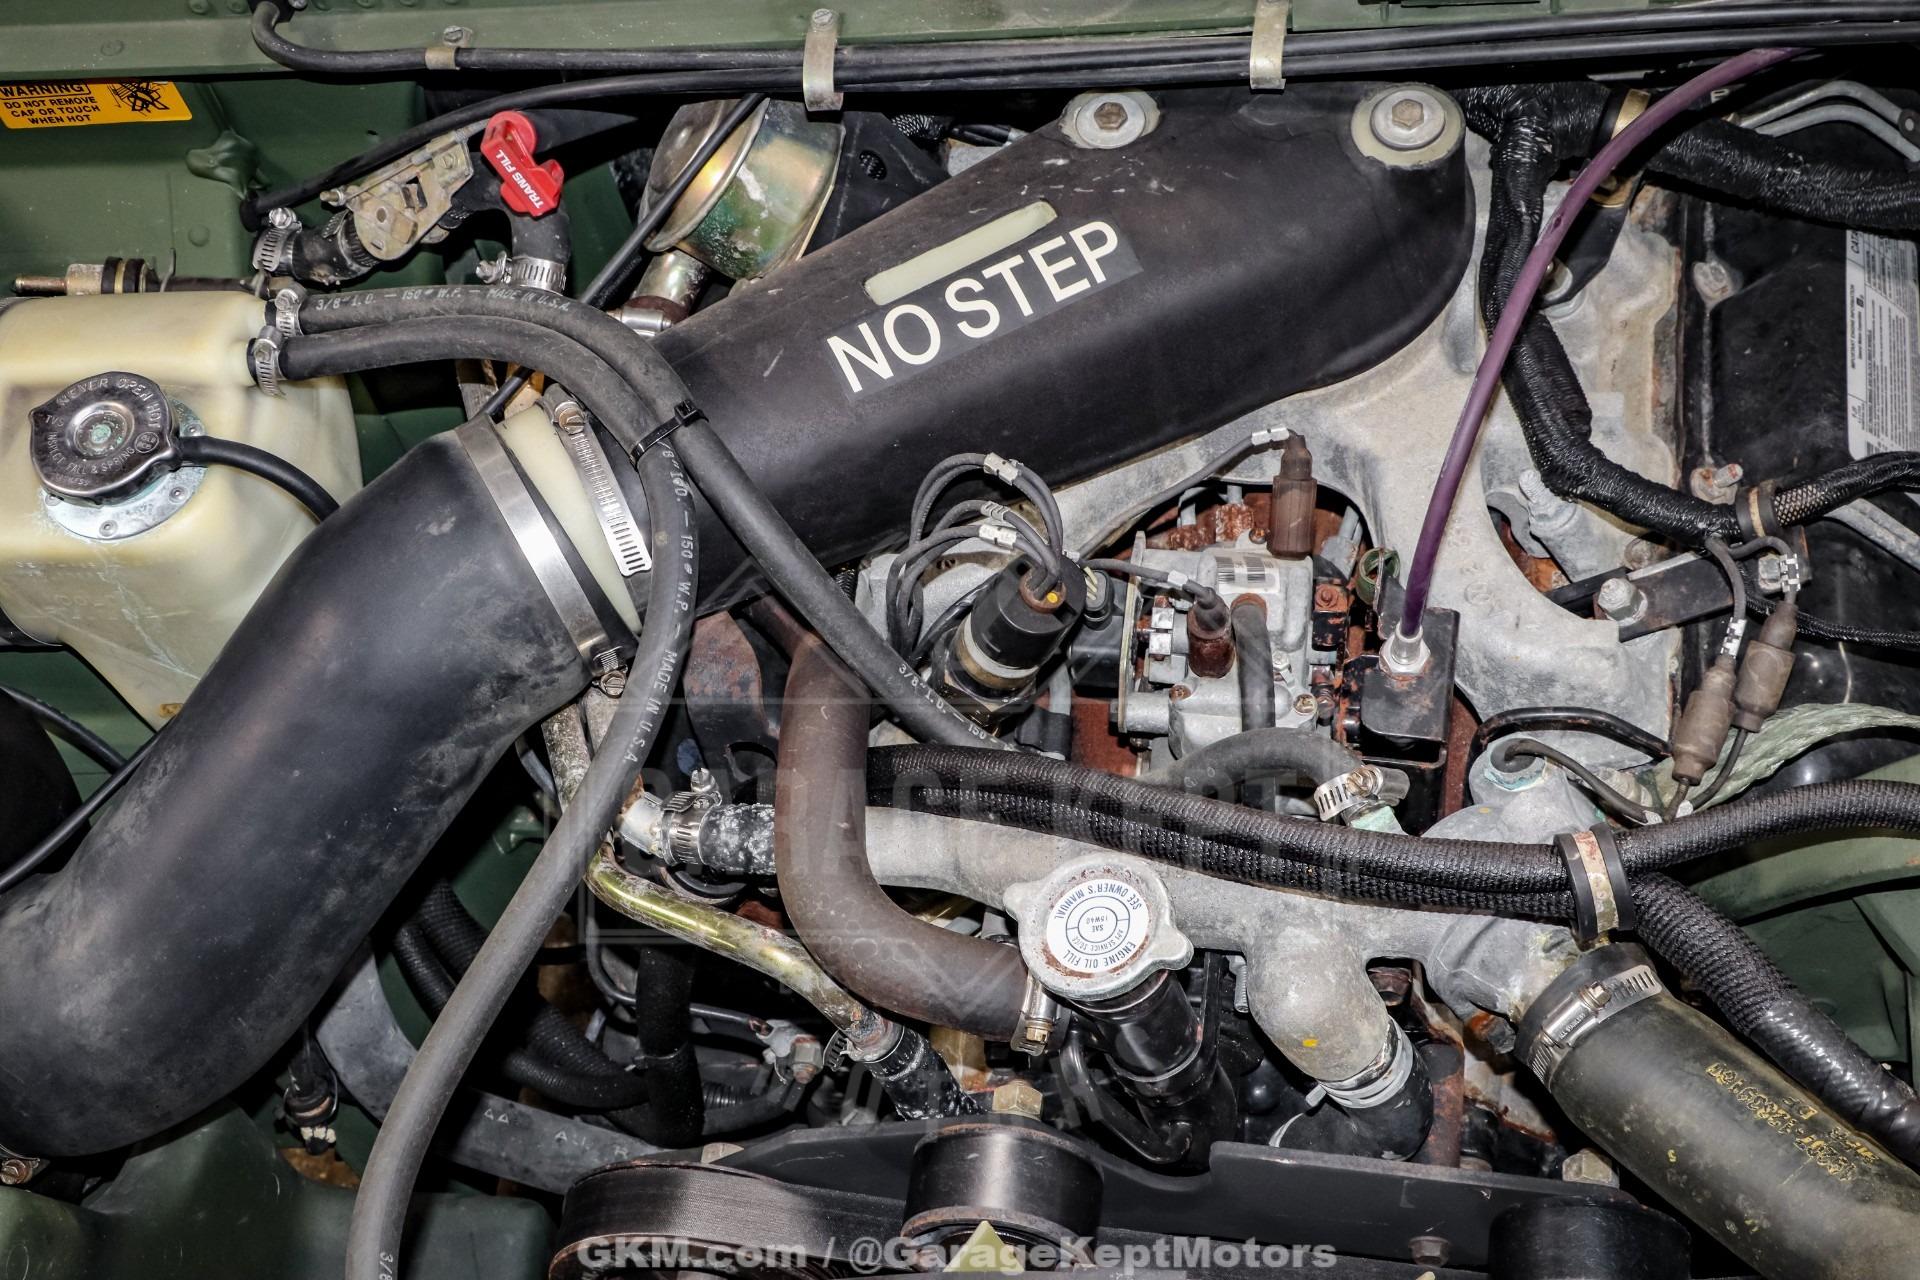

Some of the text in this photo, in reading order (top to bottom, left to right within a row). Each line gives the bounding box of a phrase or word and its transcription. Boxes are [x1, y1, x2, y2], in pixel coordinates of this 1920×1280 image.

[0, 83, 84, 98] WARNING
[4, 96, 97, 110] DO NOT REMOVE
[11, 104, 101, 118] CAP OR TOUCH
[28, 114, 92, 125] WHEN HOT
[496, 149, 544, 209] TRANS FILL
[486, 288, 521, 300] MADE
[521, 293, 533, 301] IN
[826, 220, 1119, 394] NO STEP
[56, 378, 161, 428] NEVER OPEN HOT
[47, 431, 66, 464] INSPECT
[65, 462, 87, 475] FALL
[101, 447, 137, 472] SPRING
[680, 534, 694, 559] 150
[653, 649, 678, 693] MADE
[645, 697, 663, 714] IN
[967, 723, 987, 740] 150
[1054, 882, 1142, 919] SEE OWNER'S MANUAL
[1086, 914, 1108, 925] 15W40
[1092, 924, 1104, 933] SAE
[1090, 939, 1116, 952] SERVICE
[1063, 941, 1137, 969] ENGINE OIL FILL
